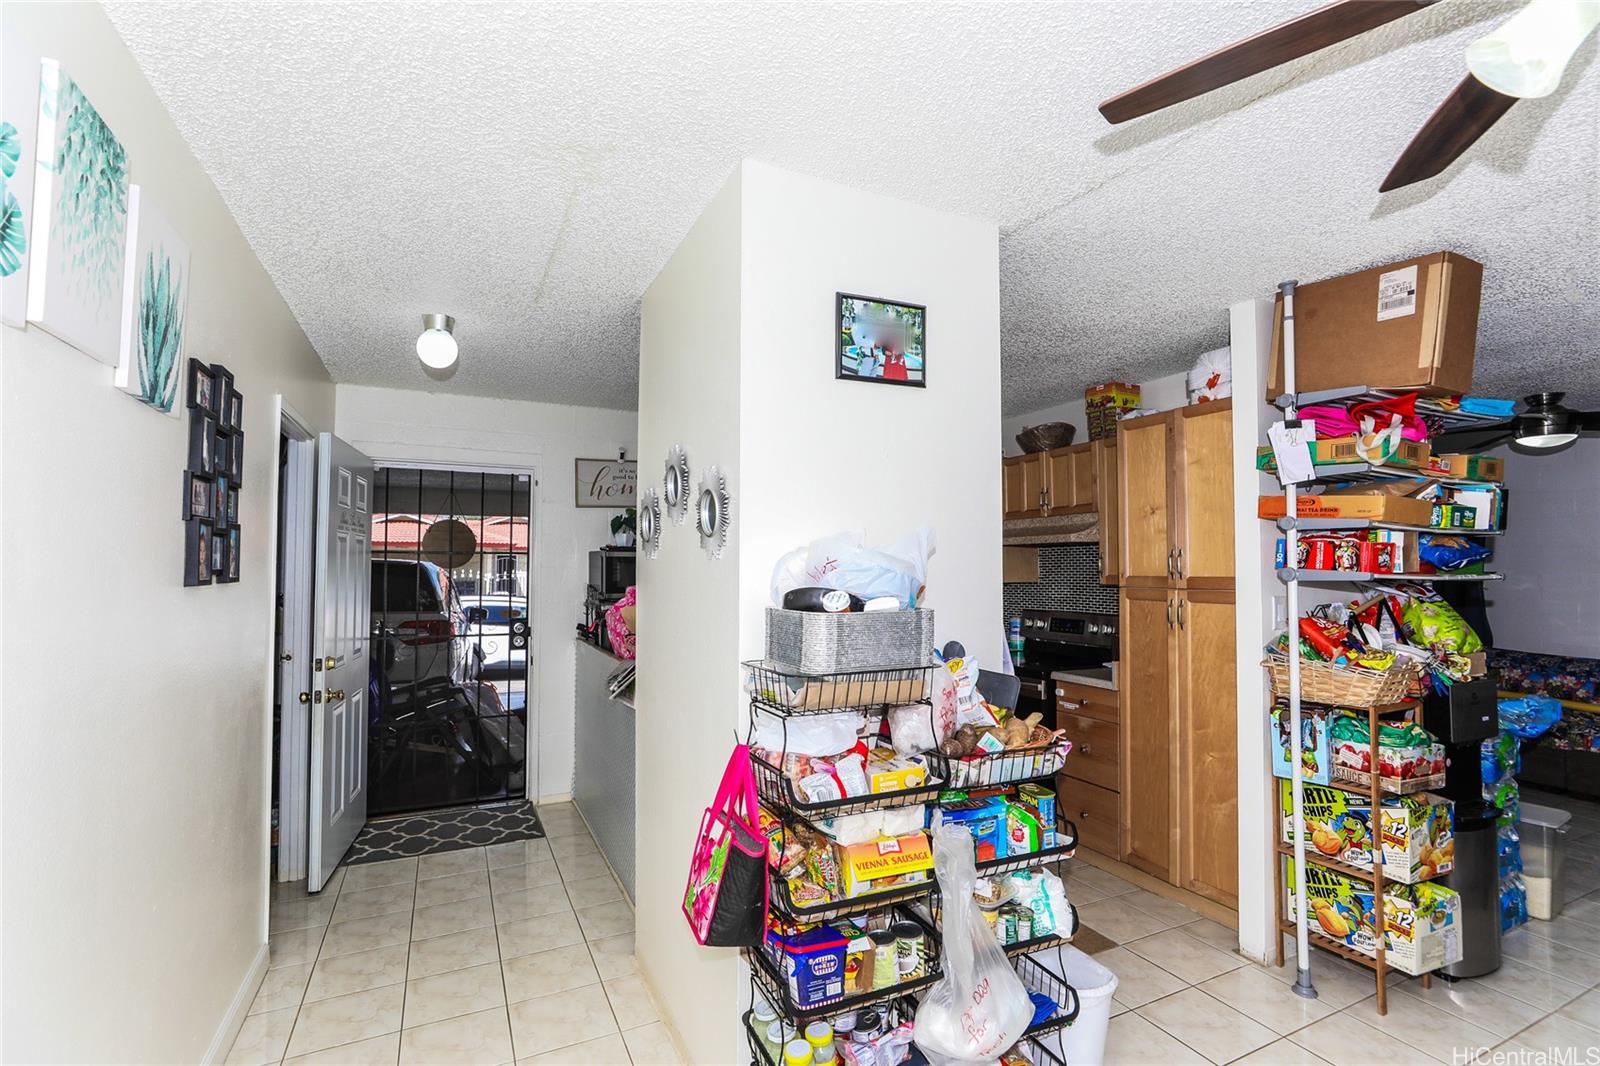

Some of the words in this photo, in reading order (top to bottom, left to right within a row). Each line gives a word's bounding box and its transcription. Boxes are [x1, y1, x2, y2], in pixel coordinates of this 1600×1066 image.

[590, 465, 637, 500] hom
[1335, 767, 1362, 780] SAUCE
[1020, 791, 1038, 807] SPAM
[1303, 805, 1334, 818] CHIPS
[855, 859, 889, 871] VIENNA
[891, 851, 929, 865] SAUSAGE
[1308, 885, 1339, 899] CHIPS
